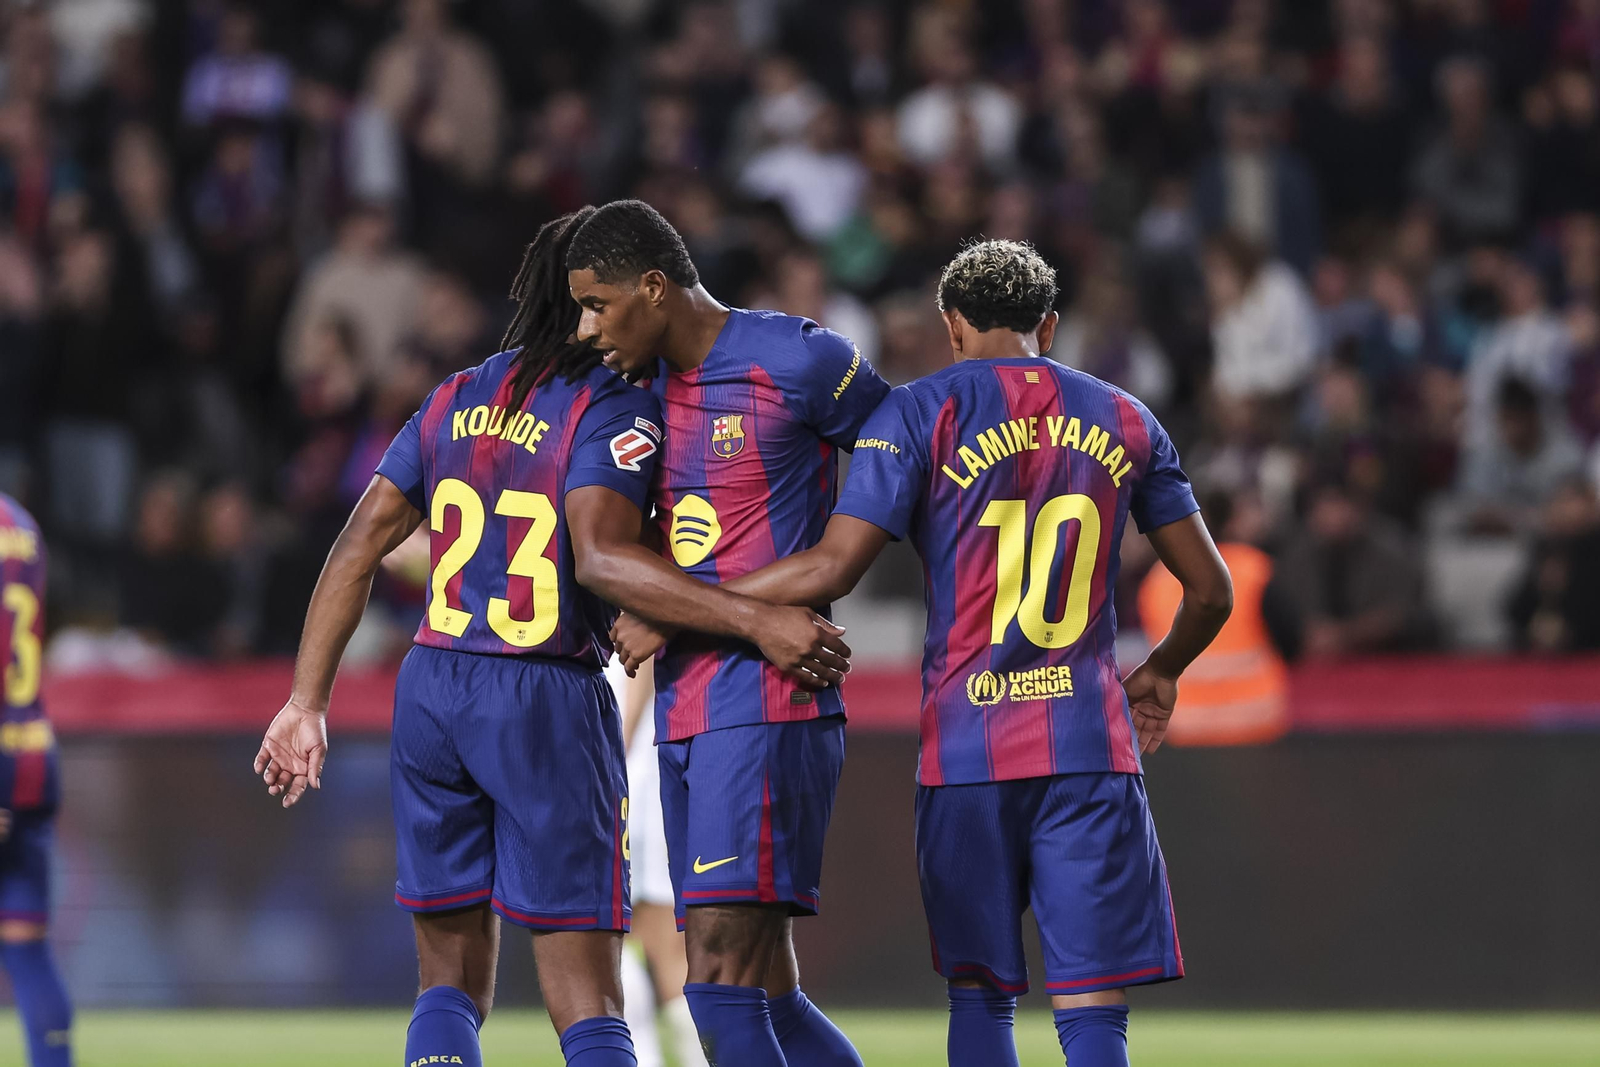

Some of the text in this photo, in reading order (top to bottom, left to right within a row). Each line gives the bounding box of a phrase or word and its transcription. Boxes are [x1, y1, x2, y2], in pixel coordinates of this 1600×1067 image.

[941, 415, 1133, 489] LAMINE YAMAL
[428, 478, 559, 647] 23
[977, 494, 1101, 649] 10
[1009, 666, 1071, 682] UNHCR
[1009, 679, 1073, 696] ACNUR
